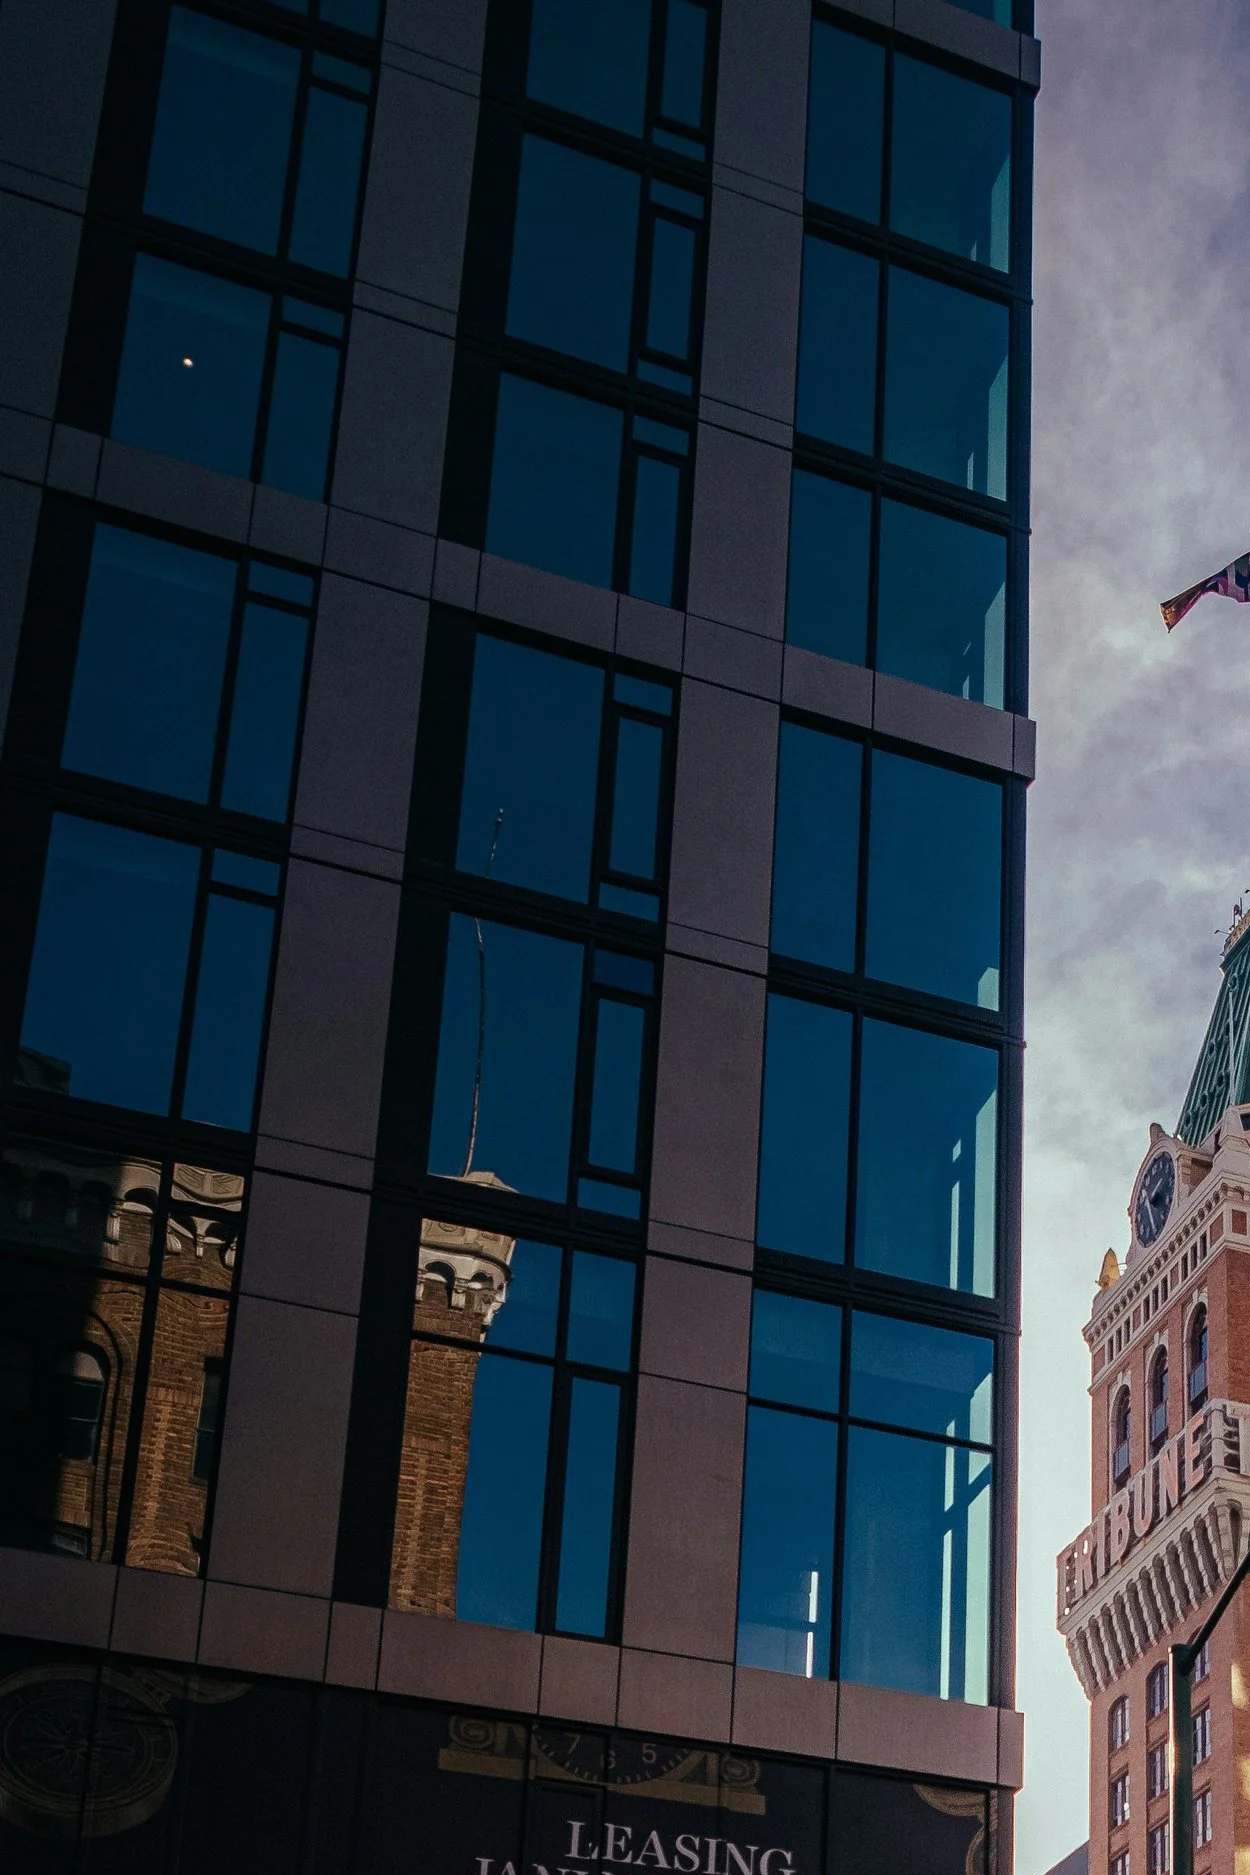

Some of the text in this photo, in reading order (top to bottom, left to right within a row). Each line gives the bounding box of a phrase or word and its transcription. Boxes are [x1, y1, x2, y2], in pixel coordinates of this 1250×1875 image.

[1058, 1412, 1205, 1620] TRIBUNE
[565, 1734, 583, 1755] 7
[641, 1743, 658, 1764] 5
